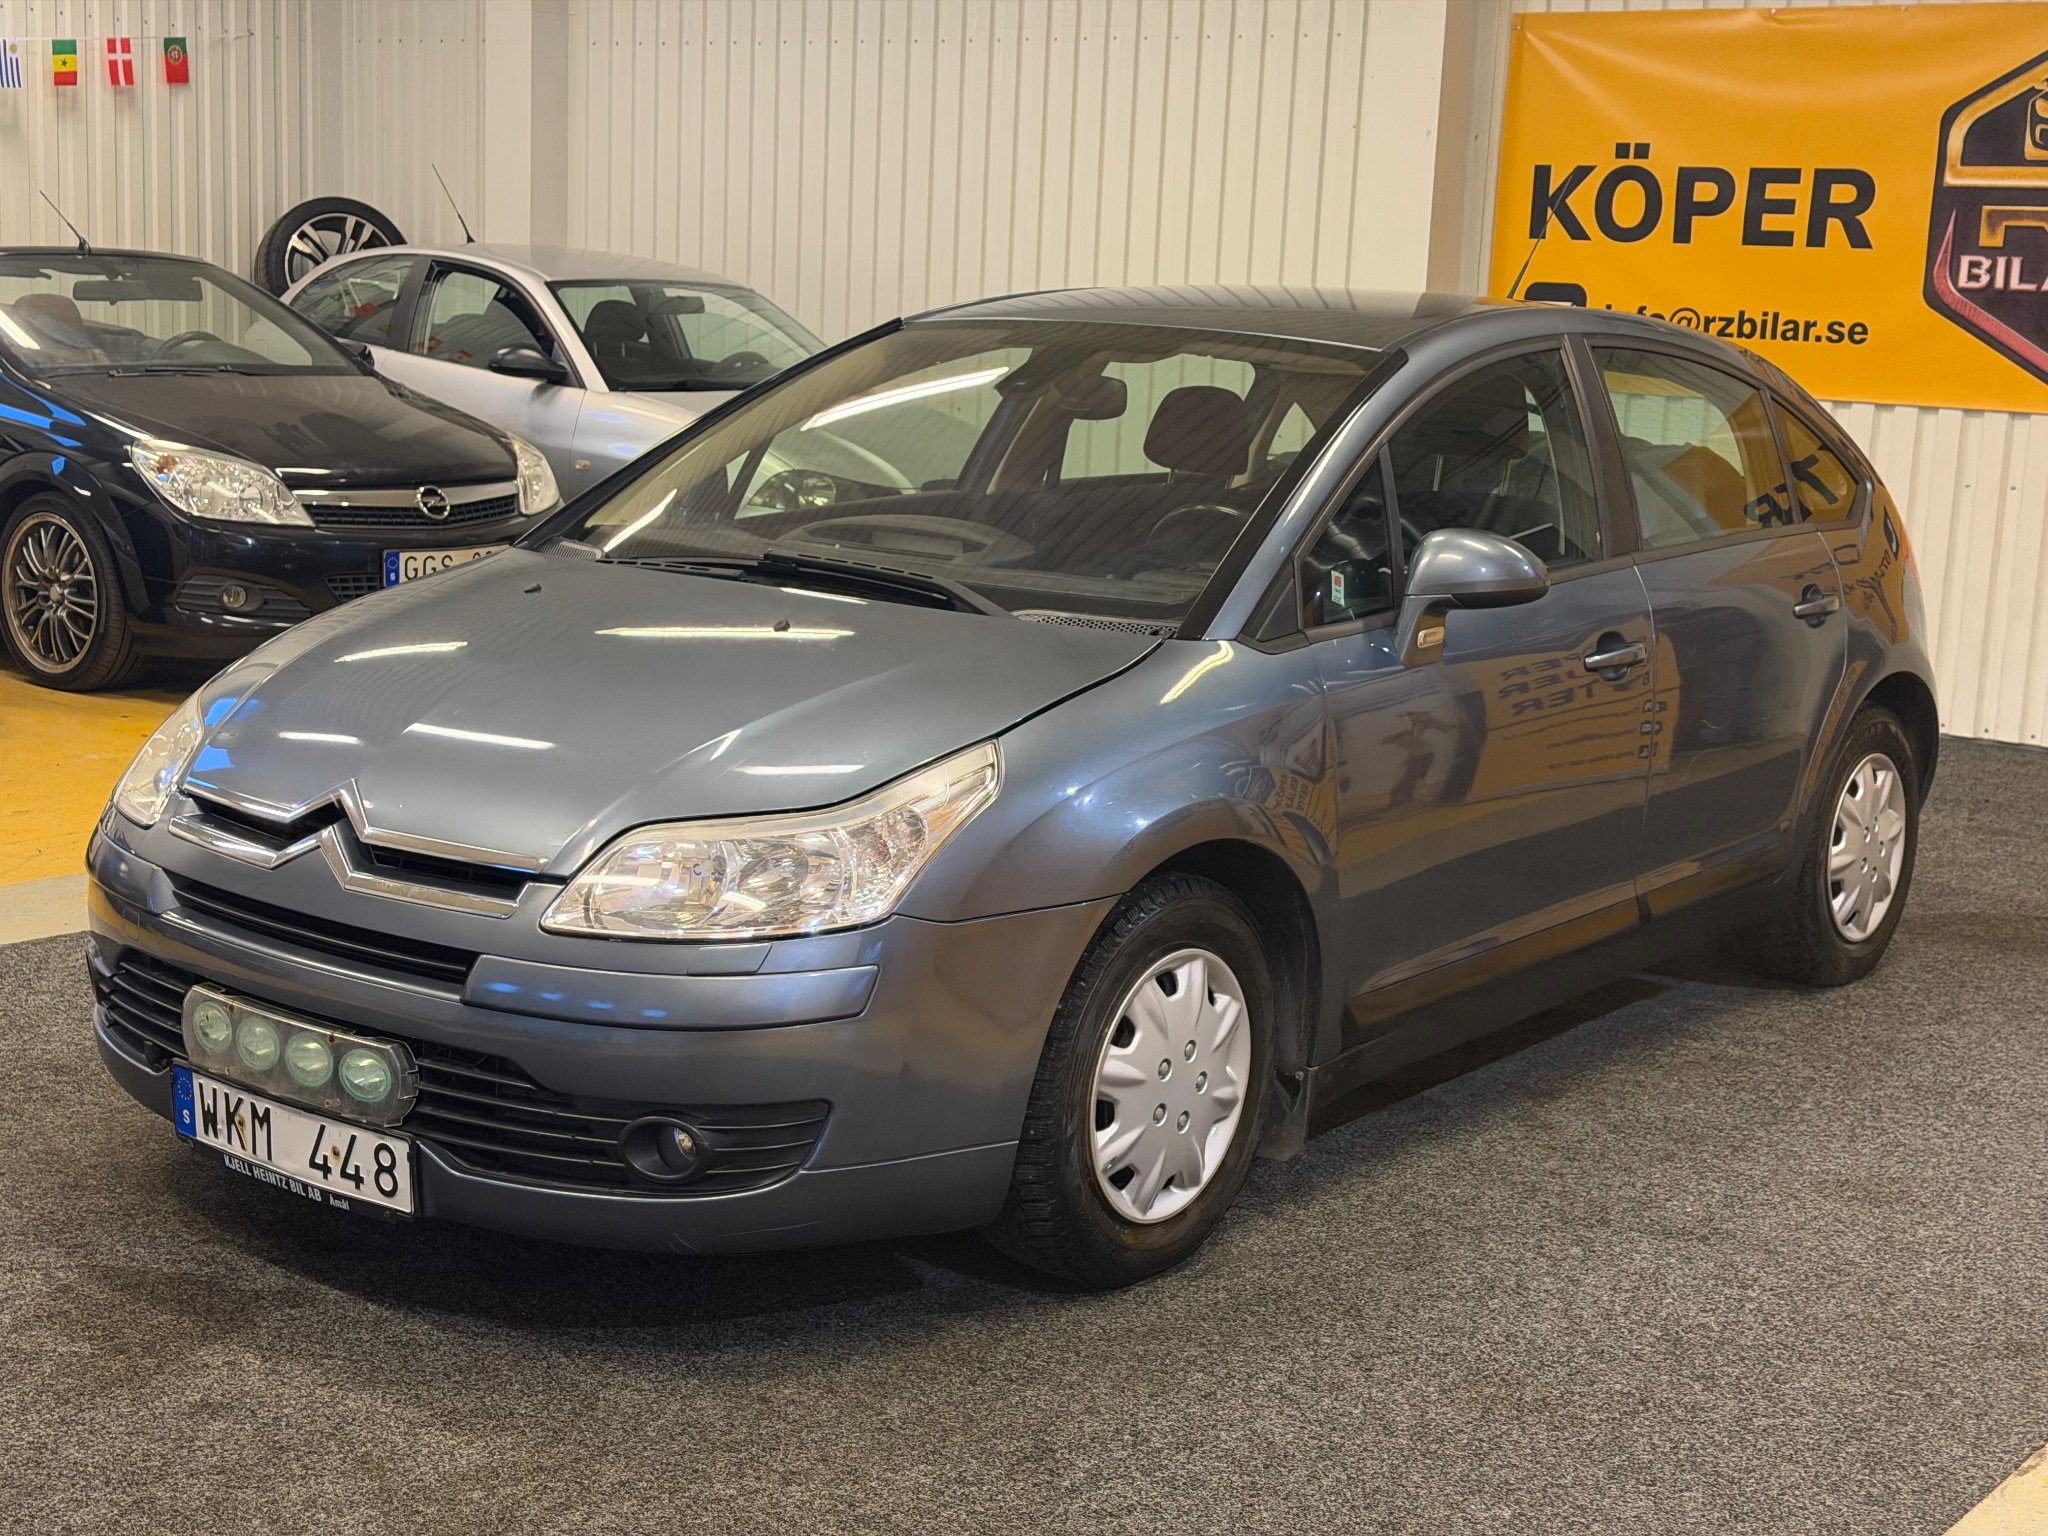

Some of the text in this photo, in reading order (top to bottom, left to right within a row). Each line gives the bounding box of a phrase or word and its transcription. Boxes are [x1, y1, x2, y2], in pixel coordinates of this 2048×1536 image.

[1529, 142, 1876, 250] KÖPER
[1957, 254, 2048, 292] BIL
[1605, 304, 1869, 346] @rzbilar.se
[182, 1108, 191, 1125] S
[198, 1080, 399, 1198] WKM 448
[223, 1154, 252, 1177] KJELL
[252, 1166, 289, 1190] HEINTZ
[289, 1179, 306, 1197] BIL
[308, 1186, 322, 1202] AB
